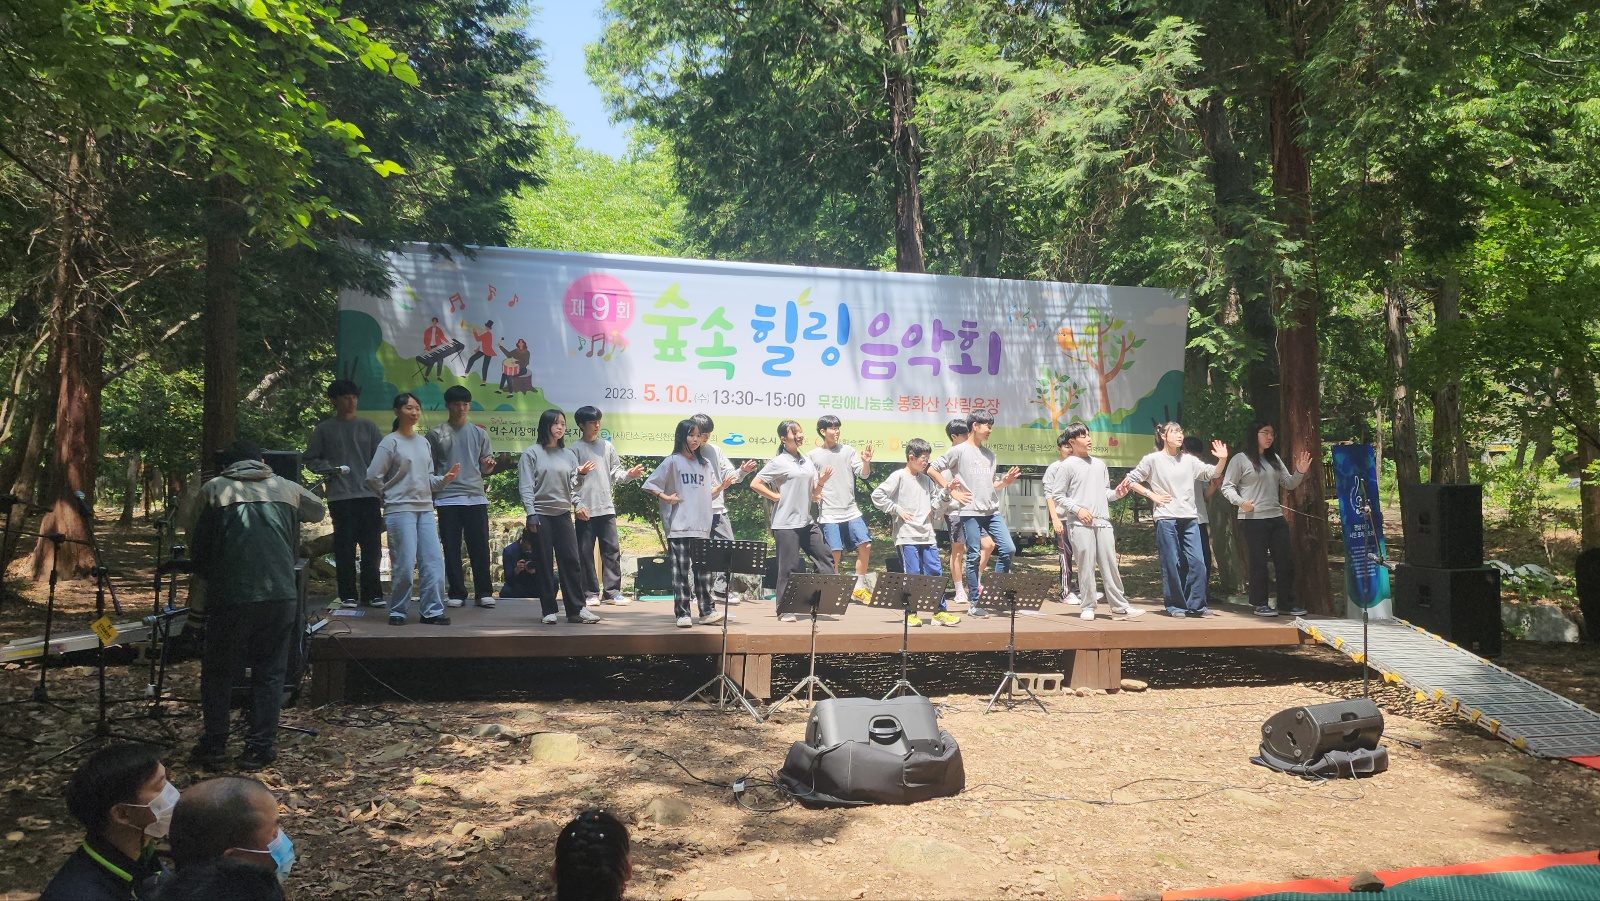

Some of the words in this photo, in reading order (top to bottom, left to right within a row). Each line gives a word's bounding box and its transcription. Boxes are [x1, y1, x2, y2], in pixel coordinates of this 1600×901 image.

[642, 282, 738, 380] 숲속
[750, 300, 851, 377] 힐링
[860, 312, 1001, 380] 음악회
[604, 387, 637, 401] 2023.
[712, 389, 807, 409] 13:30~15:00
[818, 394, 895, 412] 무장애나눔숲
[897, 395, 940, 413] 봉화산
